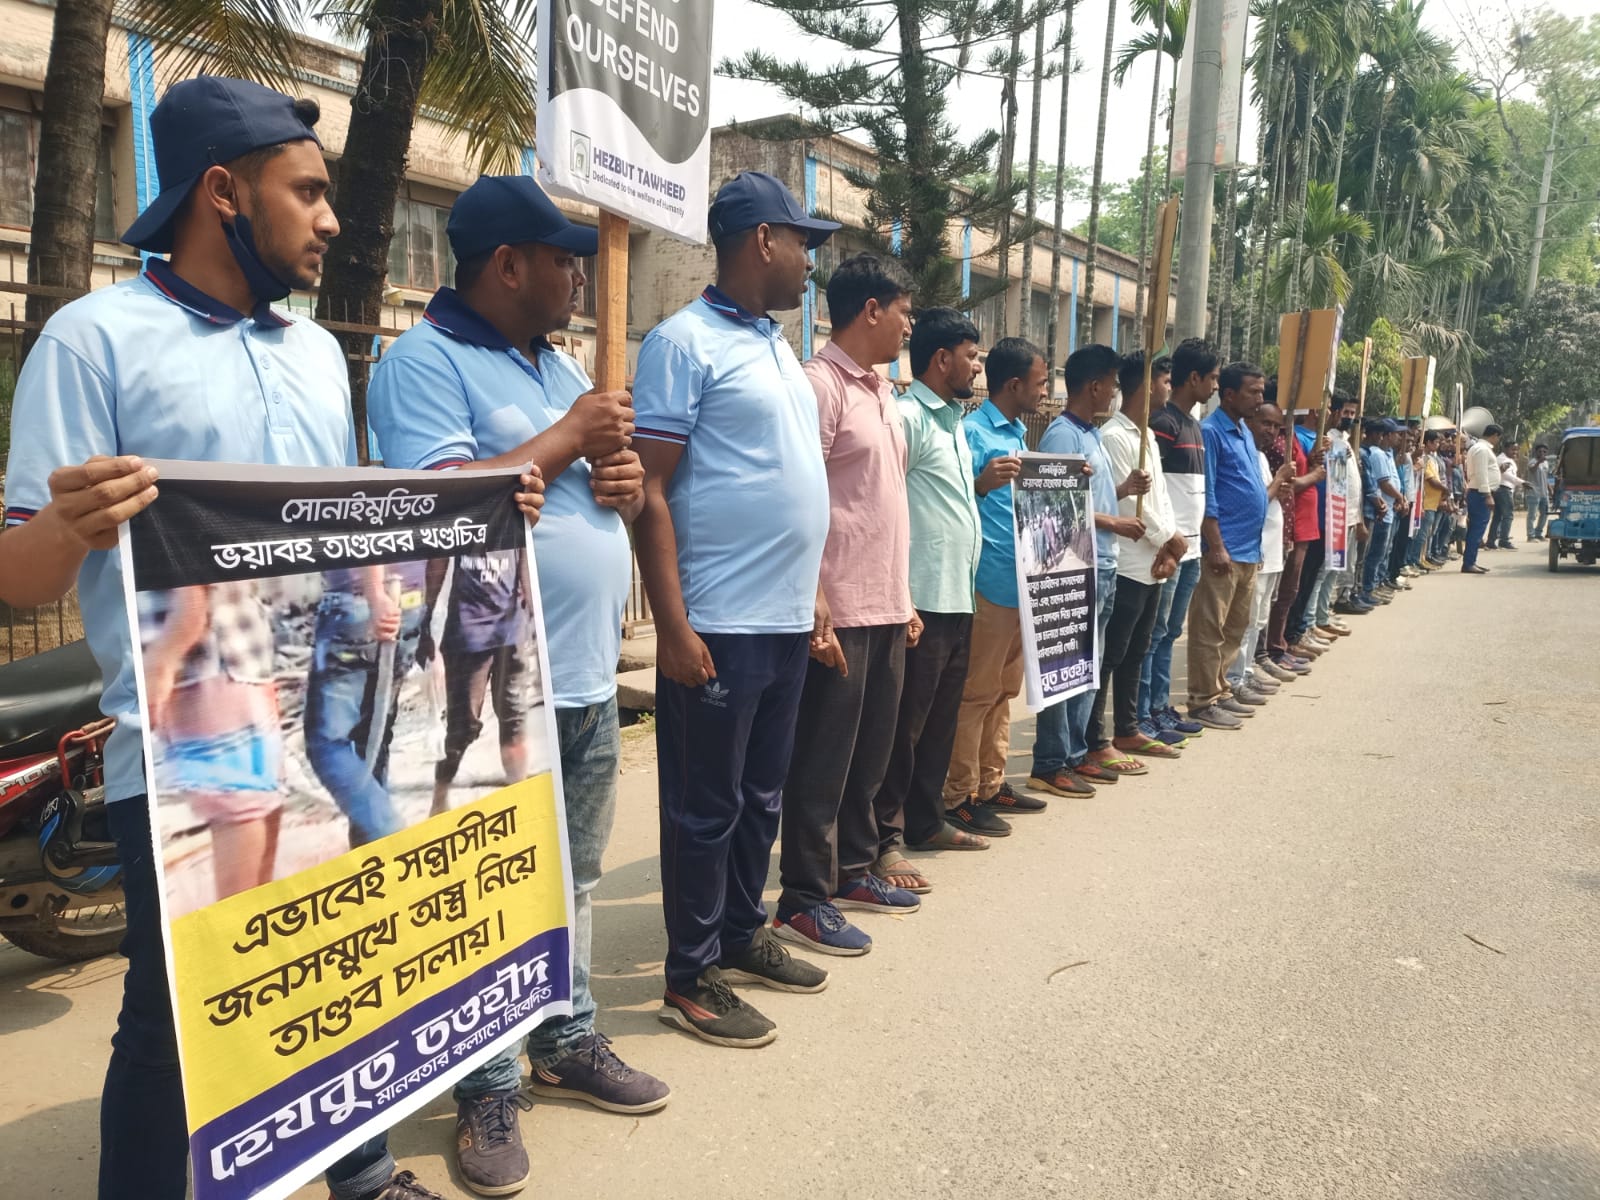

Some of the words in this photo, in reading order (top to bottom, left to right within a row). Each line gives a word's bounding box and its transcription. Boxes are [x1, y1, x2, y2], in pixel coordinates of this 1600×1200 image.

[566, 13, 700, 118] OURSELVES
[590, 0, 679, 54] EFEND
[592, 171, 620, 190] Dedicated
[621, 182, 627, 193] to
[627, 185, 636, 197] the
[637, 191, 656, 205] welfare
[656, 198, 662, 208] of
[662, 202, 685, 218] Humanity
[593, 147, 635, 180] HEZBUT
[637, 167, 686, 201] TAWHEED
[211, 537, 315, 571] ভয়াবহ
[319, 528, 416, 560] তাণ্ডবের
[421, 518, 488, 551] খণ্ডচিত্র
[281, 487, 438, 527] সোনাইমুড়িতে
[1040, 670, 1058, 692] বুত
[233, 856, 386, 955] এভাবেই
[393, 805, 518, 882] সন্ত্রাসীরা
[203, 911, 400, 1026] জনসম্মুখে
[408, 878, 468, 928] অস্ত্র
[475, 845, 537, 900] নিয়ে
[269, 974, 384, 1057] তাণ্ডব
[393, 909, 506, 997] চালায়।
[210, 1039, 400, 1182] হেযবুত
[411, 951, 550, 1056] তওহীদ
[375, 1049, 450, 1106] মানবতার
[452, 1016, 501, 1057] কল্যাণে
[503, 984, 553, 1027] নিবেদিত
